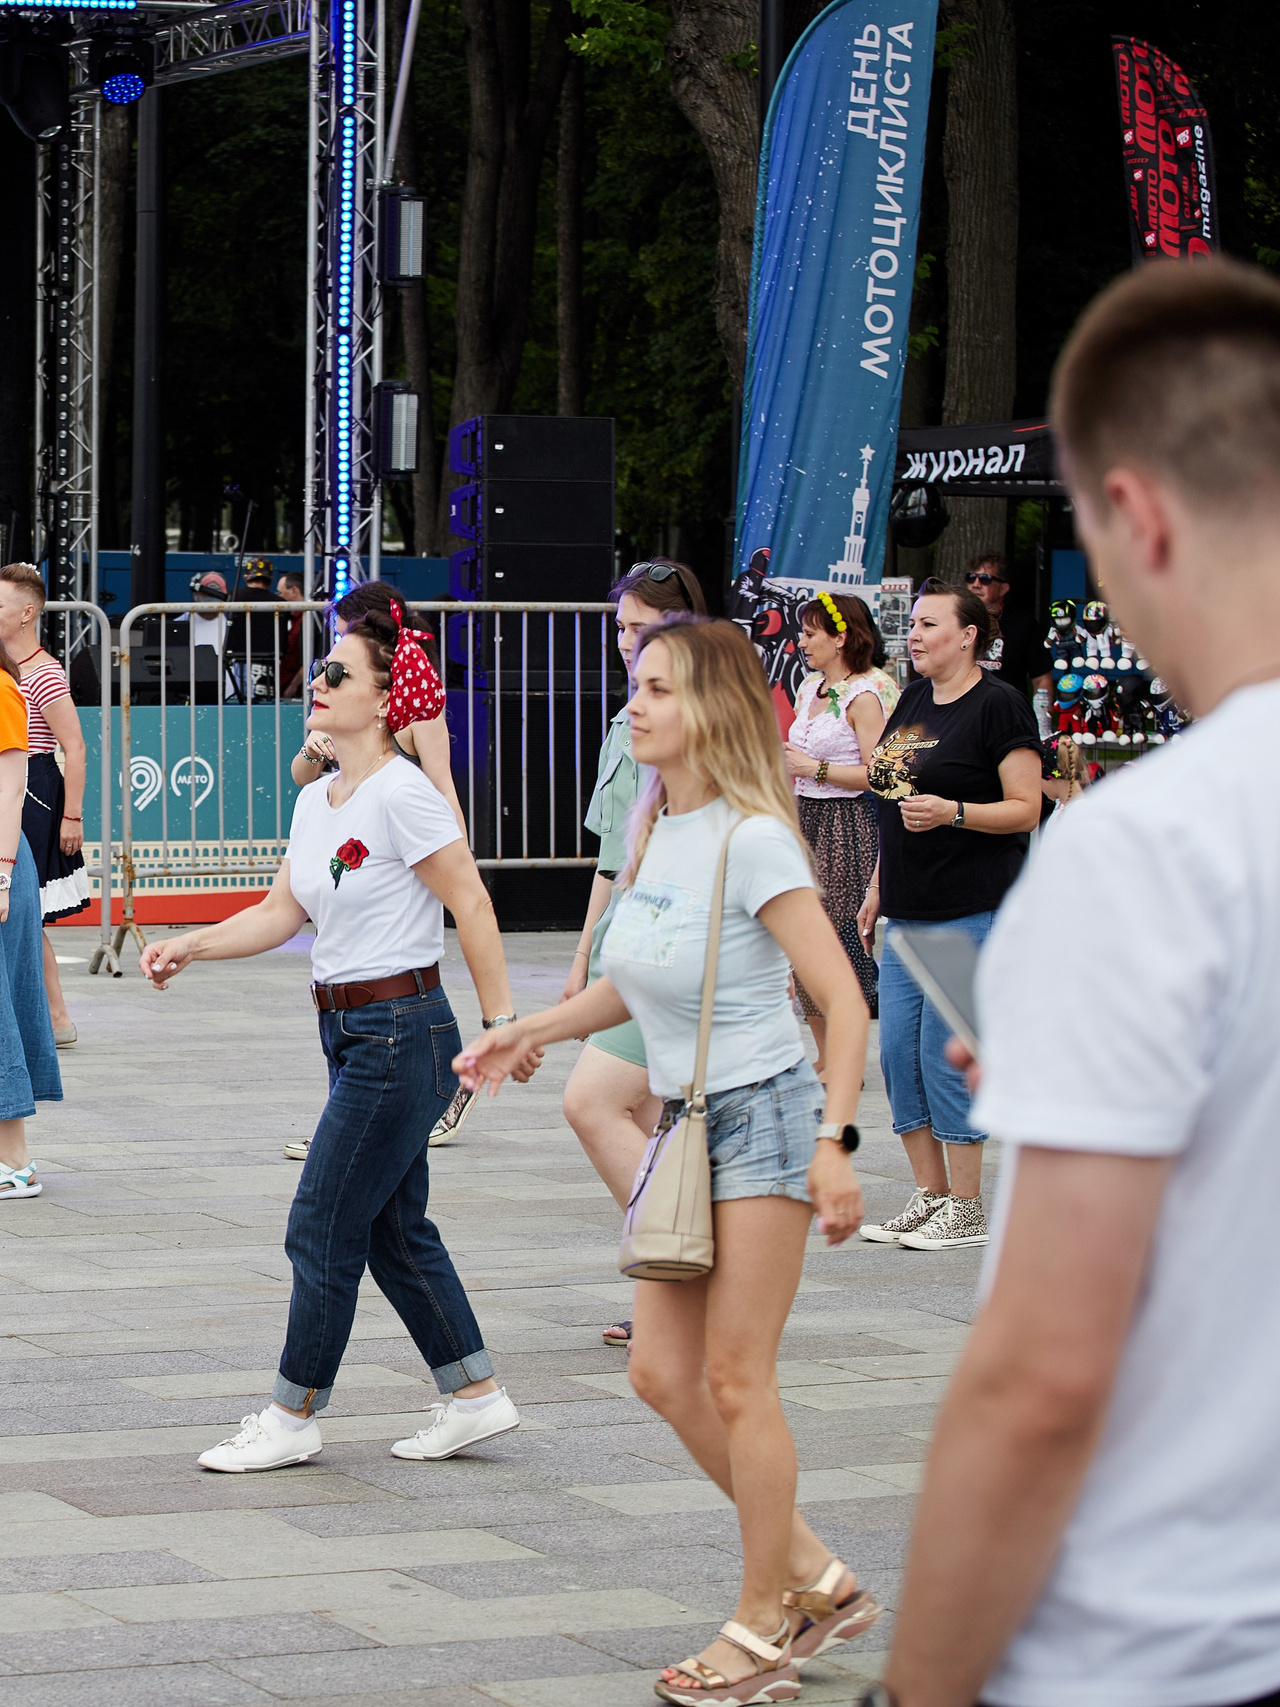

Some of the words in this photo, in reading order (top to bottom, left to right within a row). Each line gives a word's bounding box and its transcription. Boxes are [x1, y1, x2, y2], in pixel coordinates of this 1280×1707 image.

[847, 23, 882, 140] ДЕНЬ
[860, 22, 915, 380] МОТОЦИКЛИСТА
[1158, 119, 1180, 258] MOTO
[1194, 125, 1212, 239] magazine
[901, 443, 1026, 484] журнал
